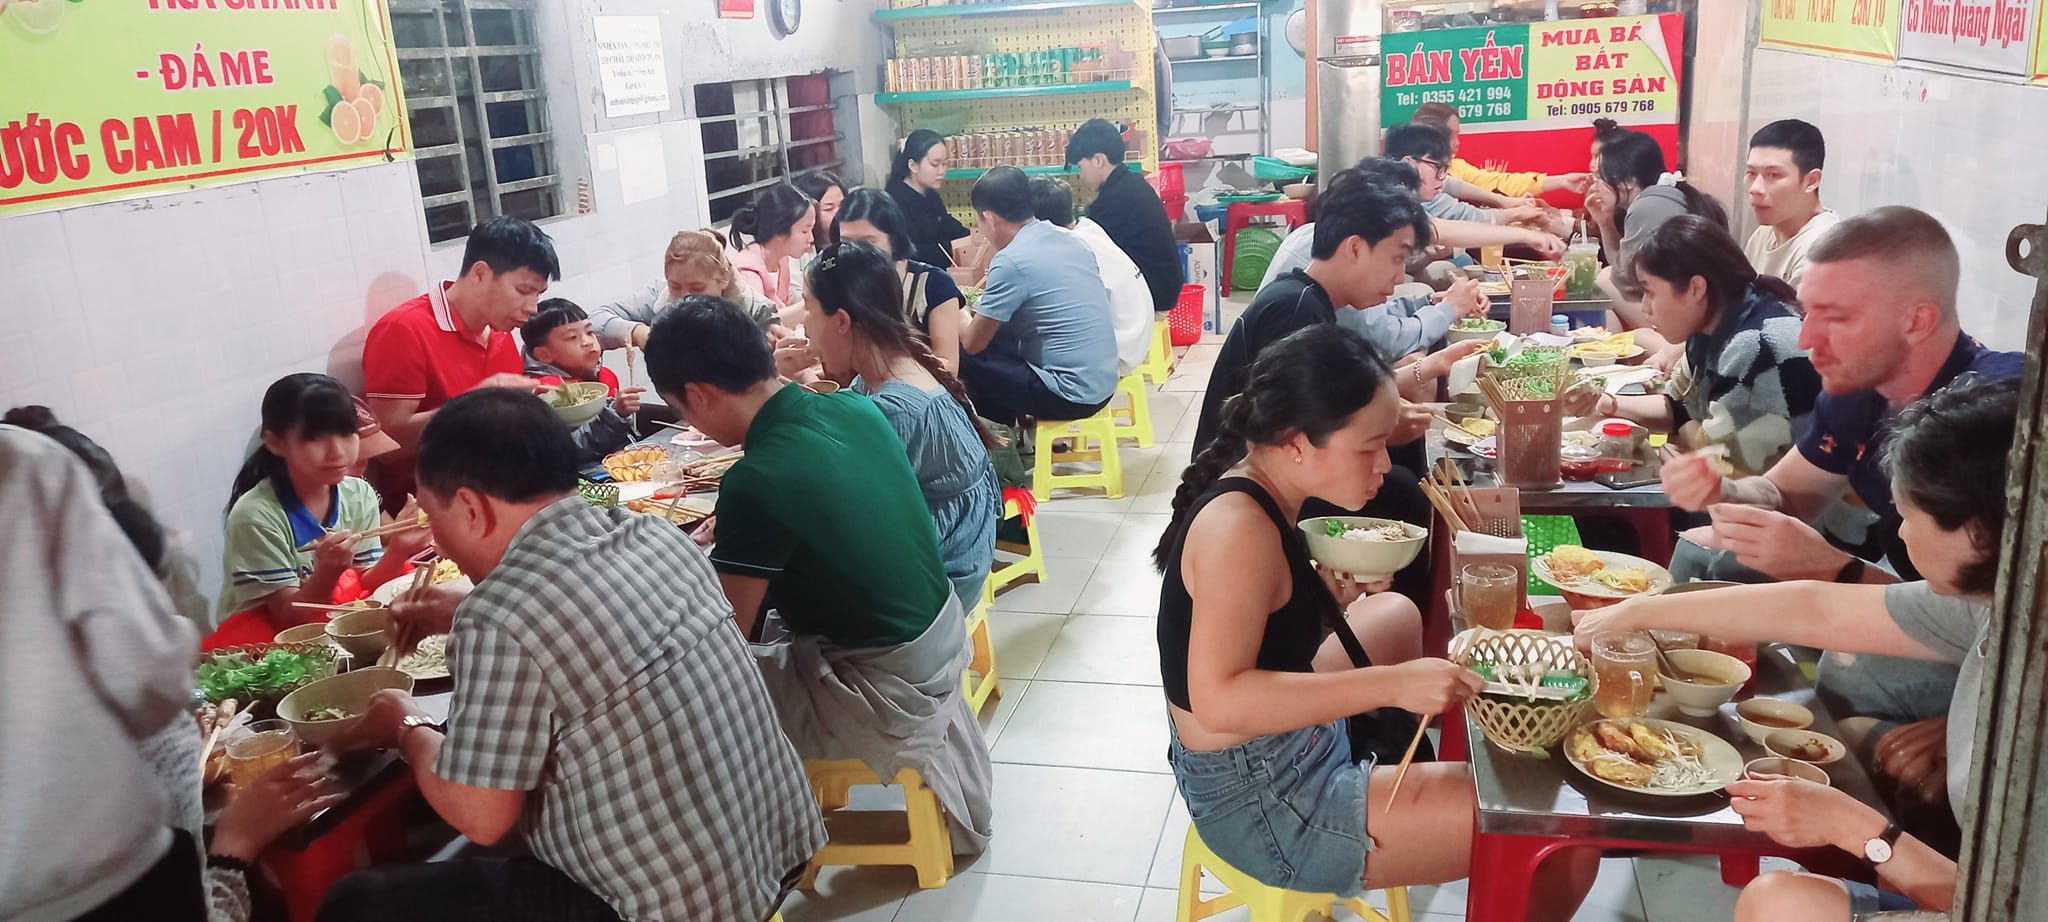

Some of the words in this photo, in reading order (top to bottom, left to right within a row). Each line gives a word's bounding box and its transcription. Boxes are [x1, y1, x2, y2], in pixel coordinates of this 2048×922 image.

[1541, 28, 1600, 47] MUA
[159, 43, 216, 90] ĐÁ
[220, 50, 273, 86] ME
[1386, 42, 1451, 86] BÁN
[1459, 30, 1523, 81] YẾN
[1576, 46, 1628, 71] BẤT
[1396, 92, 1418, 106] Tel:
[1422, 90, 1454, 104] 0355
[1458, 88, 1481, 102] 421
[1487, 86, 1511, 100] 994
[1537, 78, 1604, 103] ĐỘNG
[1613, 73, 1666, 93] SẢN
[1458, 104, 1482, 118] 679
[1487, 102, 1511, 117] 768
[1547, 104, 1567, 117] Tel:
[1571, 102, 1601, 115] 0905
[1604, 101, 1629, 114] 679
[1632, 100, 1655, 113] 768
[100, 112, 202, 174] CAM
[233, 104, 305, 159] 20K
